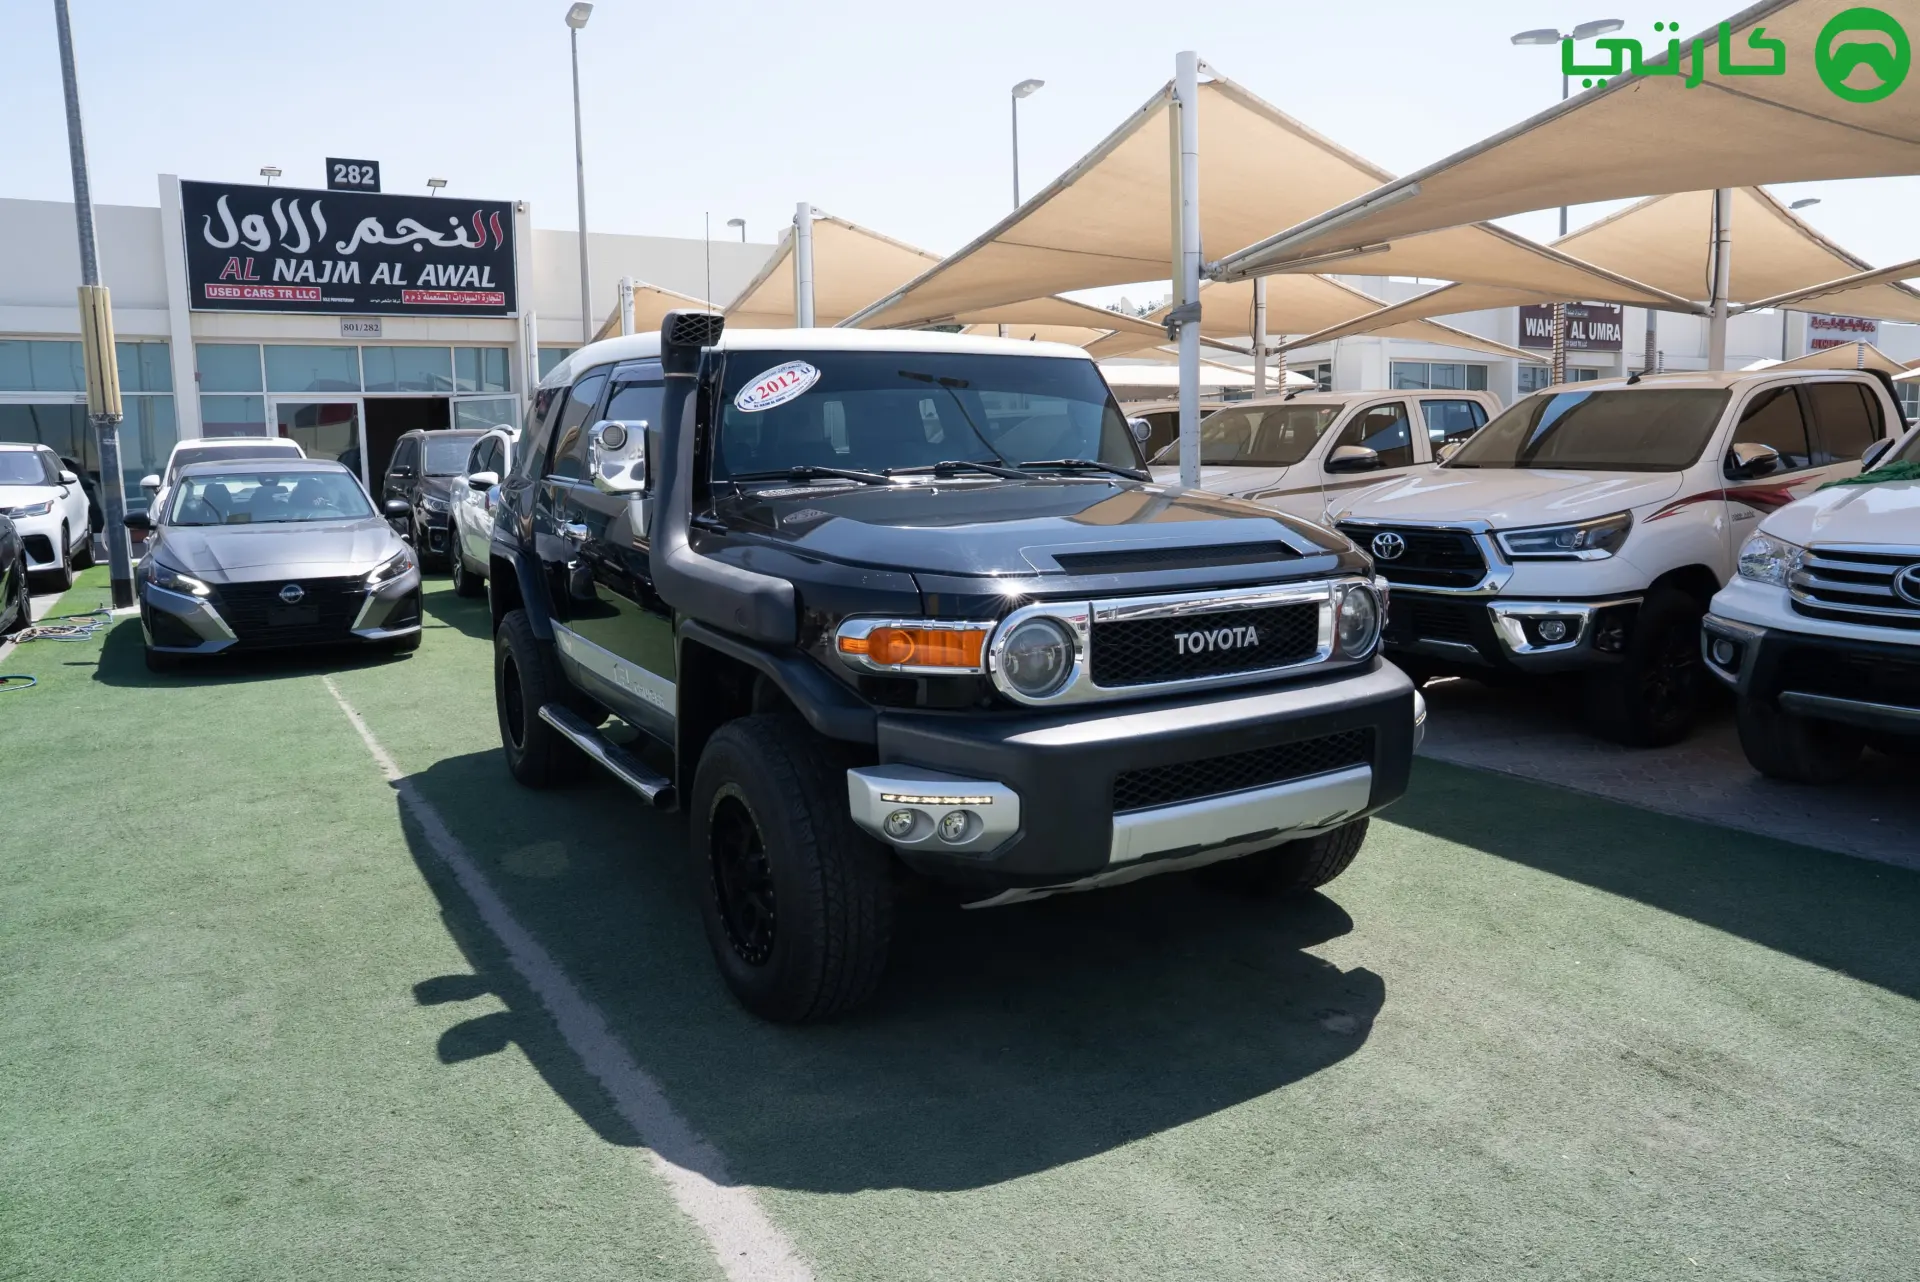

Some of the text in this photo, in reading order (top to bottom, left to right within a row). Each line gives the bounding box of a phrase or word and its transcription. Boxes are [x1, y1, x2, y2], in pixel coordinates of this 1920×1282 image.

[334, 164, 375, 185] 282
[335, 209, 504, 255] النجم
[219, 256, 496, 288] AL NAJM AL AWAL
[209, 287, 317, 299] USED CARS TR LLC
[343, 322, 380, 334] 801/282
[1525, 317, 1621, 342] WAH AL UMRA
[756, 370, 800, 399] 2012
[1174, 626, 1259, 655] TOYOTA
